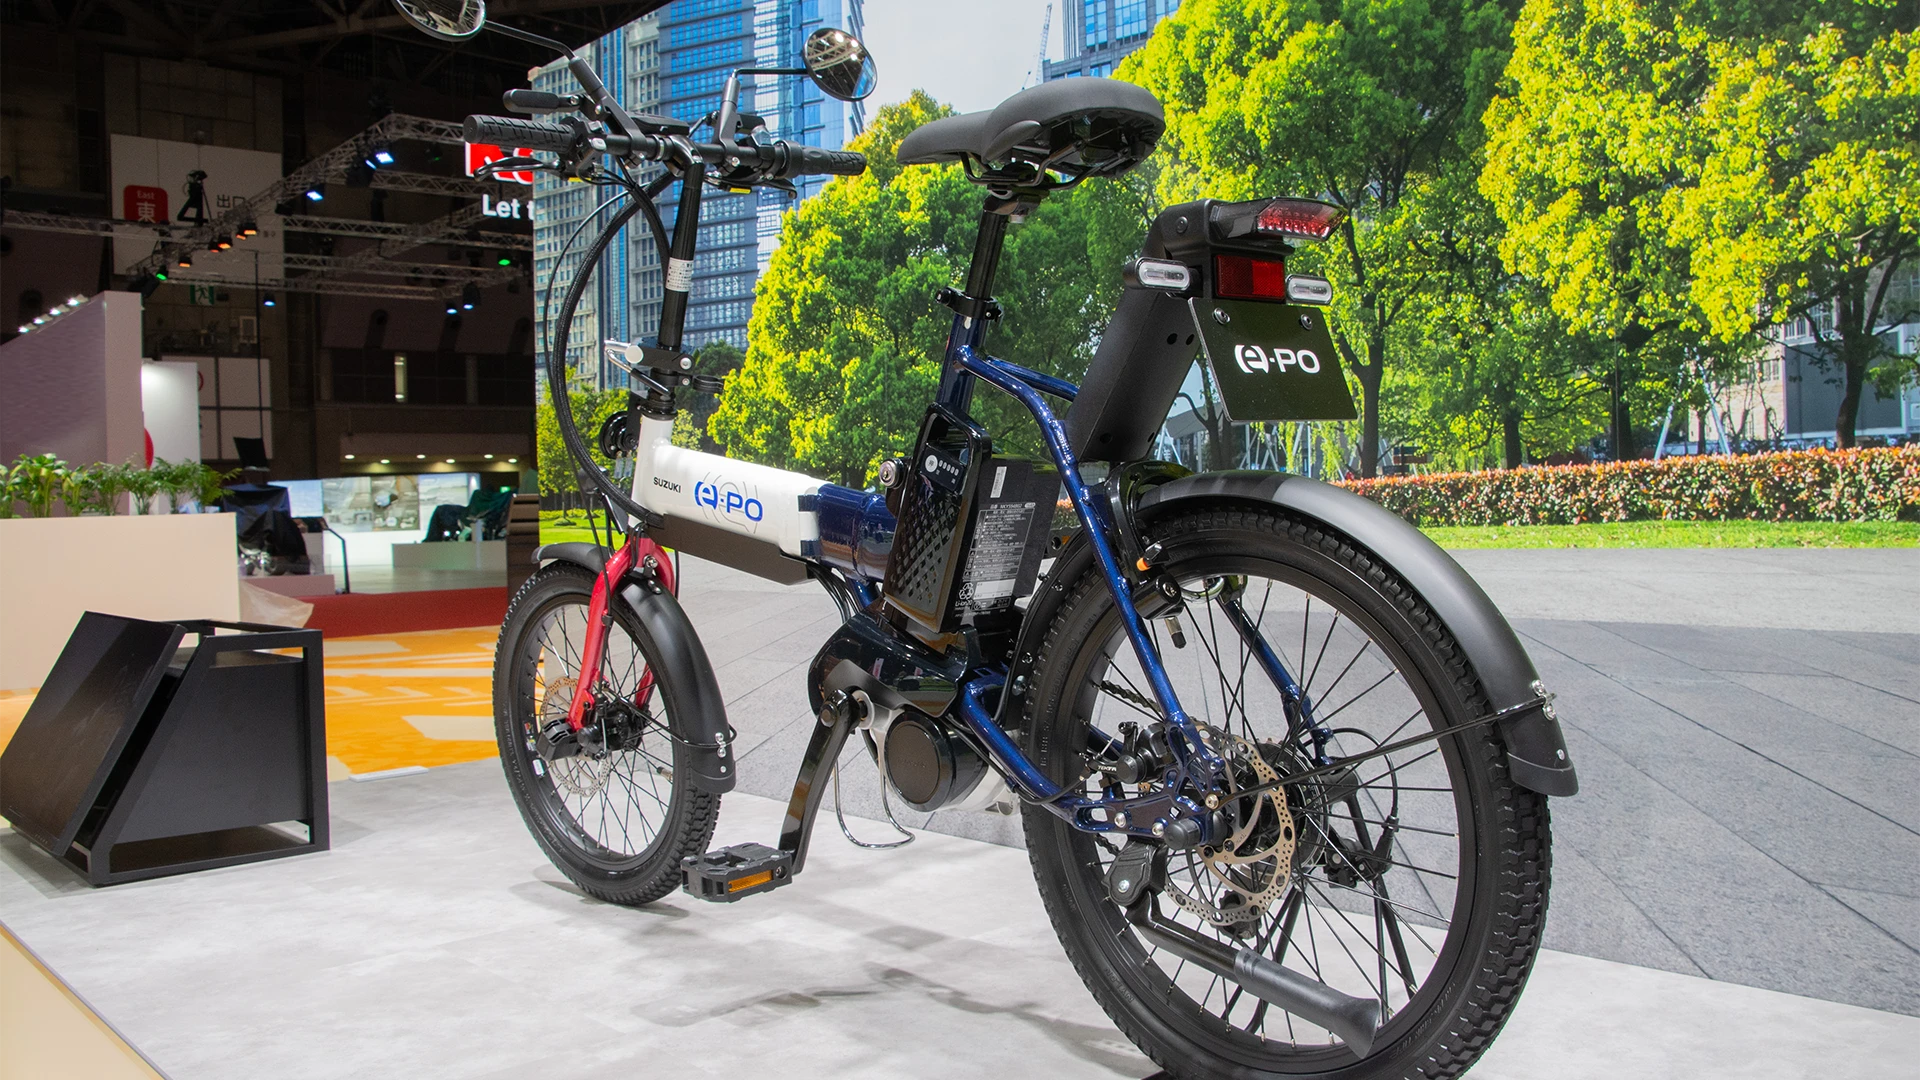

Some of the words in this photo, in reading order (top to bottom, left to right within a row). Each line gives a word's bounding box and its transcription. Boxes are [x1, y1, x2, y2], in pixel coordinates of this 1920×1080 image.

[136, 190, 156, 200] East
[136, 201, 156, 224] 東
[482, 194, 521, 219] Let
[653, 476, 682, 494] SUZUKI
